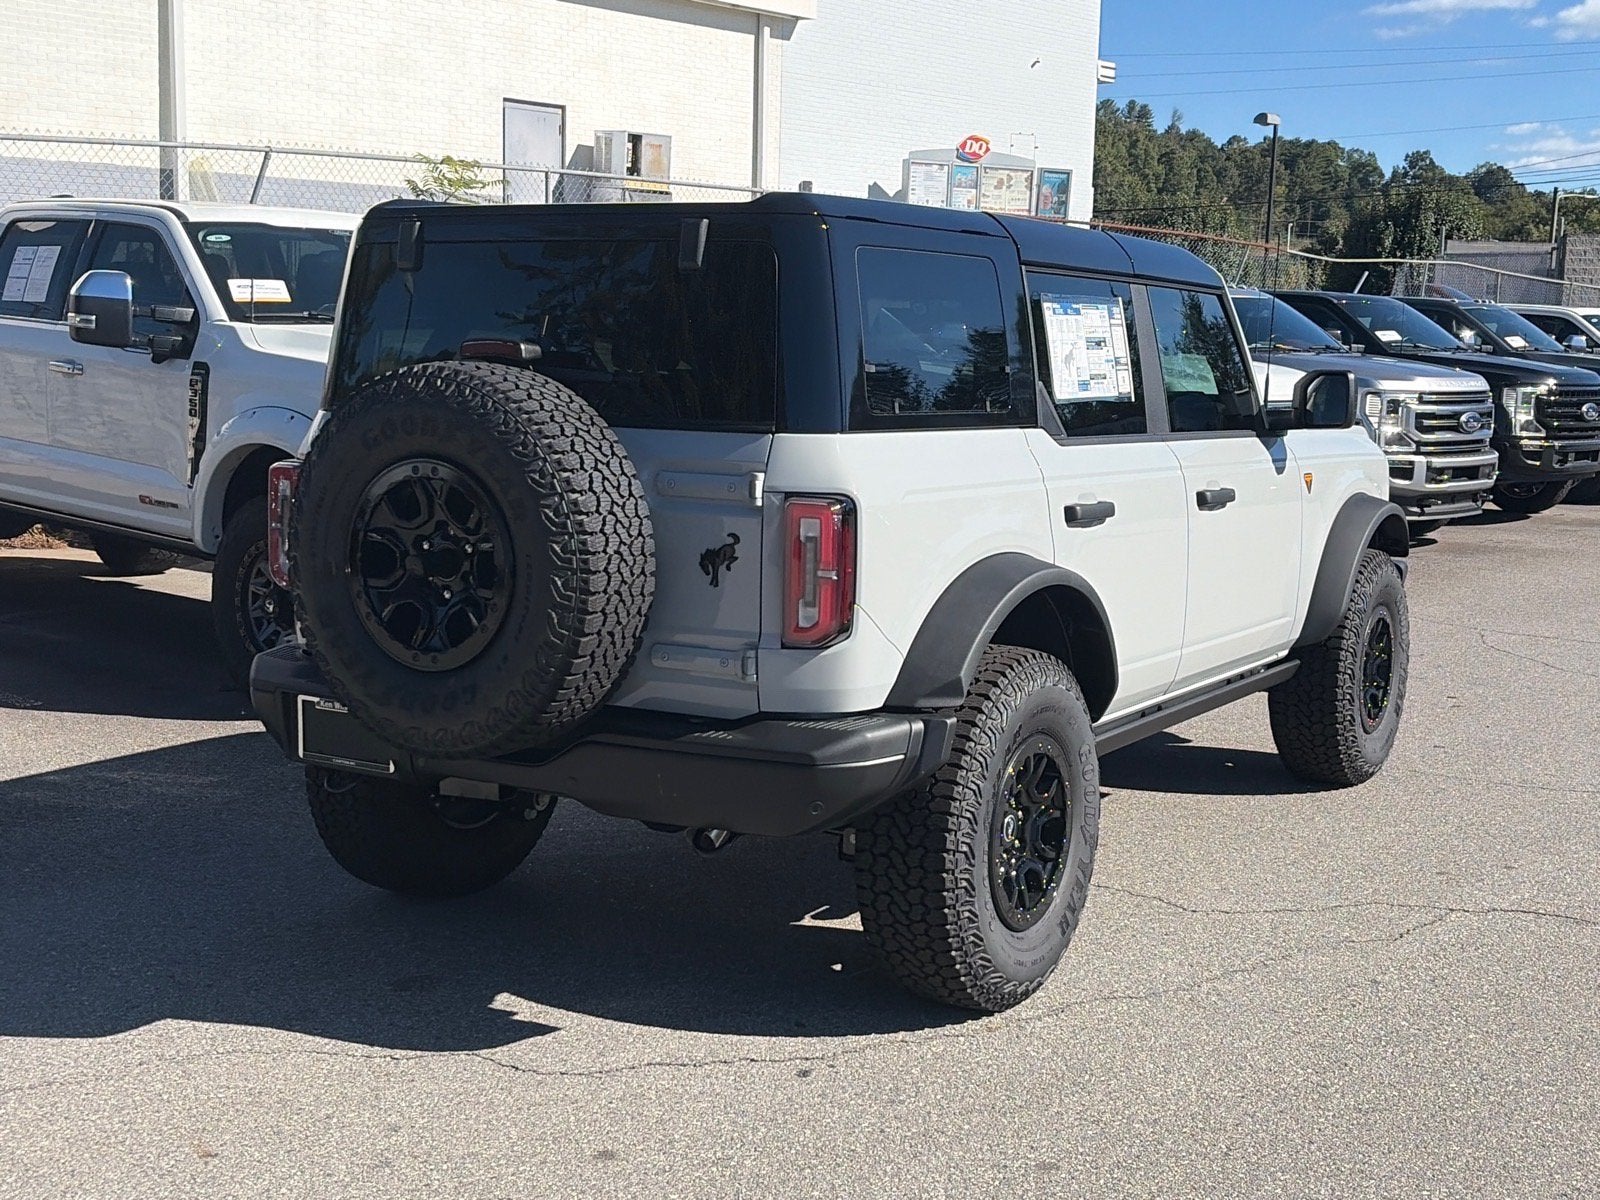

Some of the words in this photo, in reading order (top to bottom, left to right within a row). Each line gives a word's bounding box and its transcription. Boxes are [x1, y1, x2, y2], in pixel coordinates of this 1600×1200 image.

[964, 139, 987, 156] DQ
[320, 700, 333, 709] Ken
[1057, 743, 1098, 938] GOODYEAR
